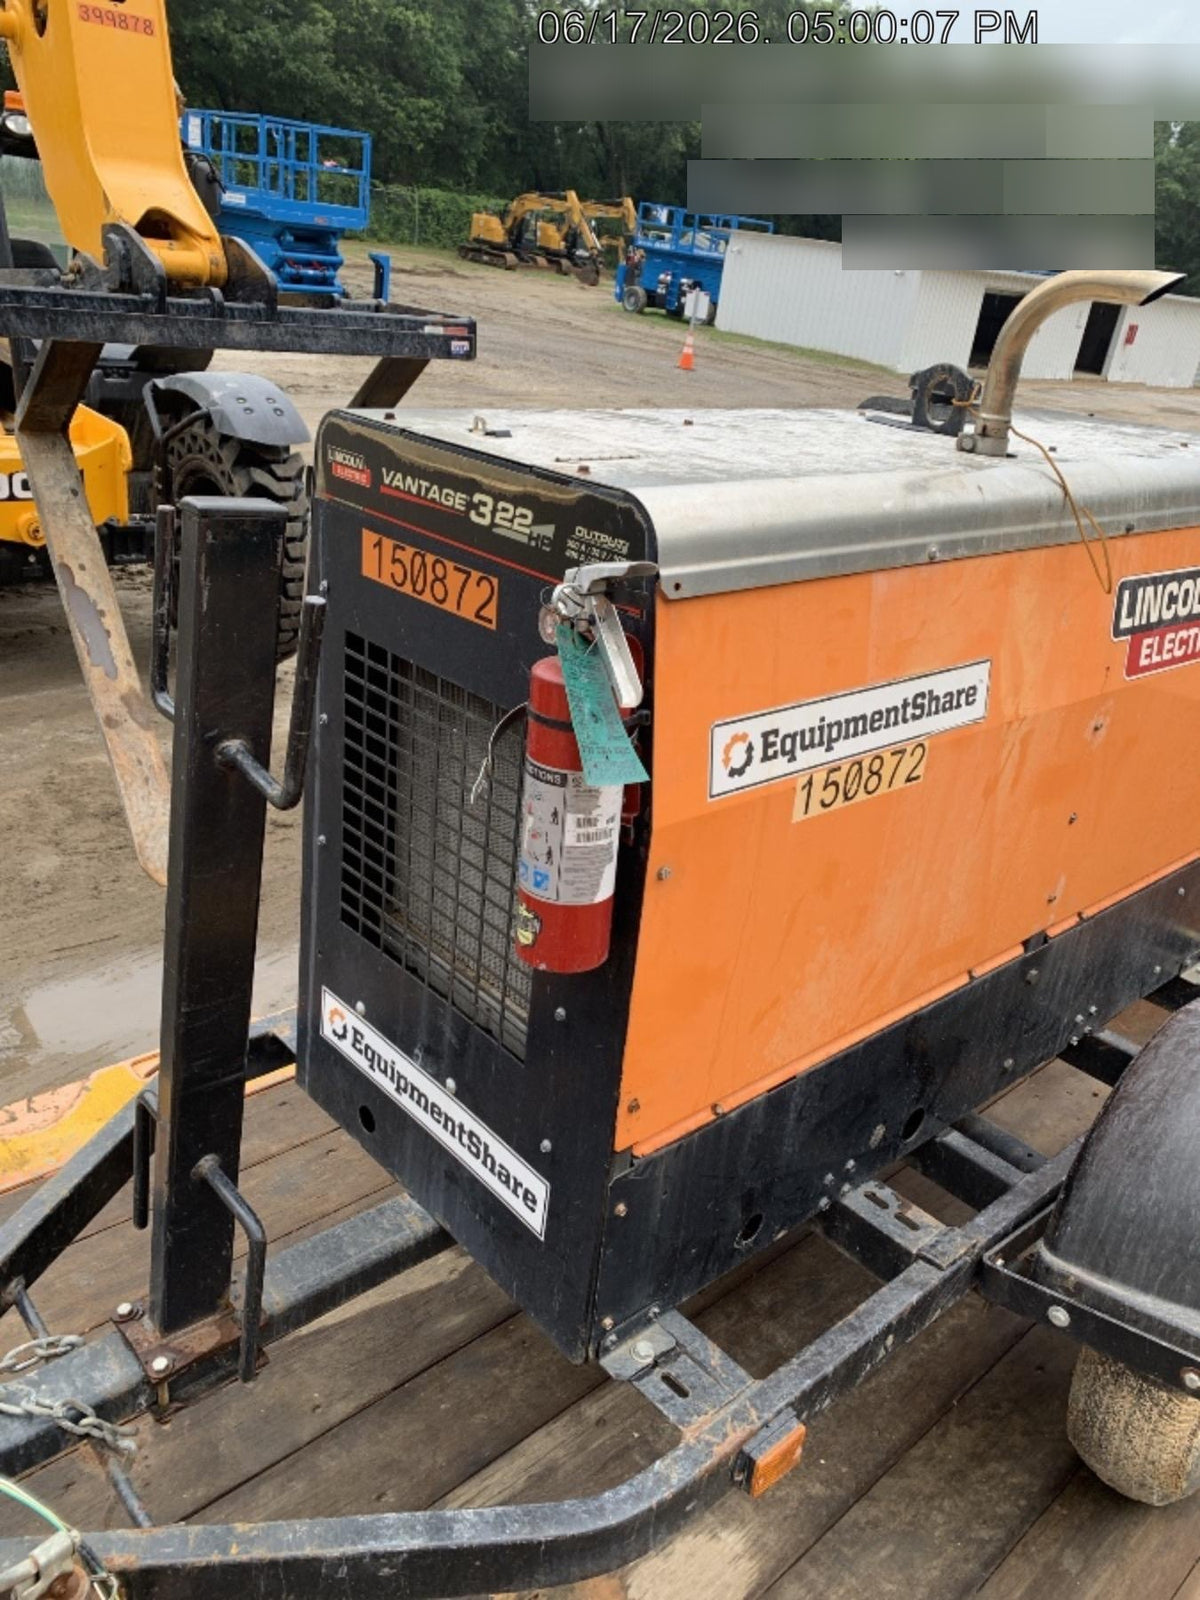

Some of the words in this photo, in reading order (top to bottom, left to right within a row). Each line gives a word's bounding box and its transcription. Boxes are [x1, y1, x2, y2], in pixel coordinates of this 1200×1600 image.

[79, 4, 154, 36] 399878
[381, 467, 467, 511] VANTAGE
[469, 491, 533, 535] 322
[373, 536, 494, 624] 150872
[760, 684, 977, 763] EquipmentShare
[801, 742, 926, 815] 150872
[351, 1025, 539, 1214] EquipmentShare
